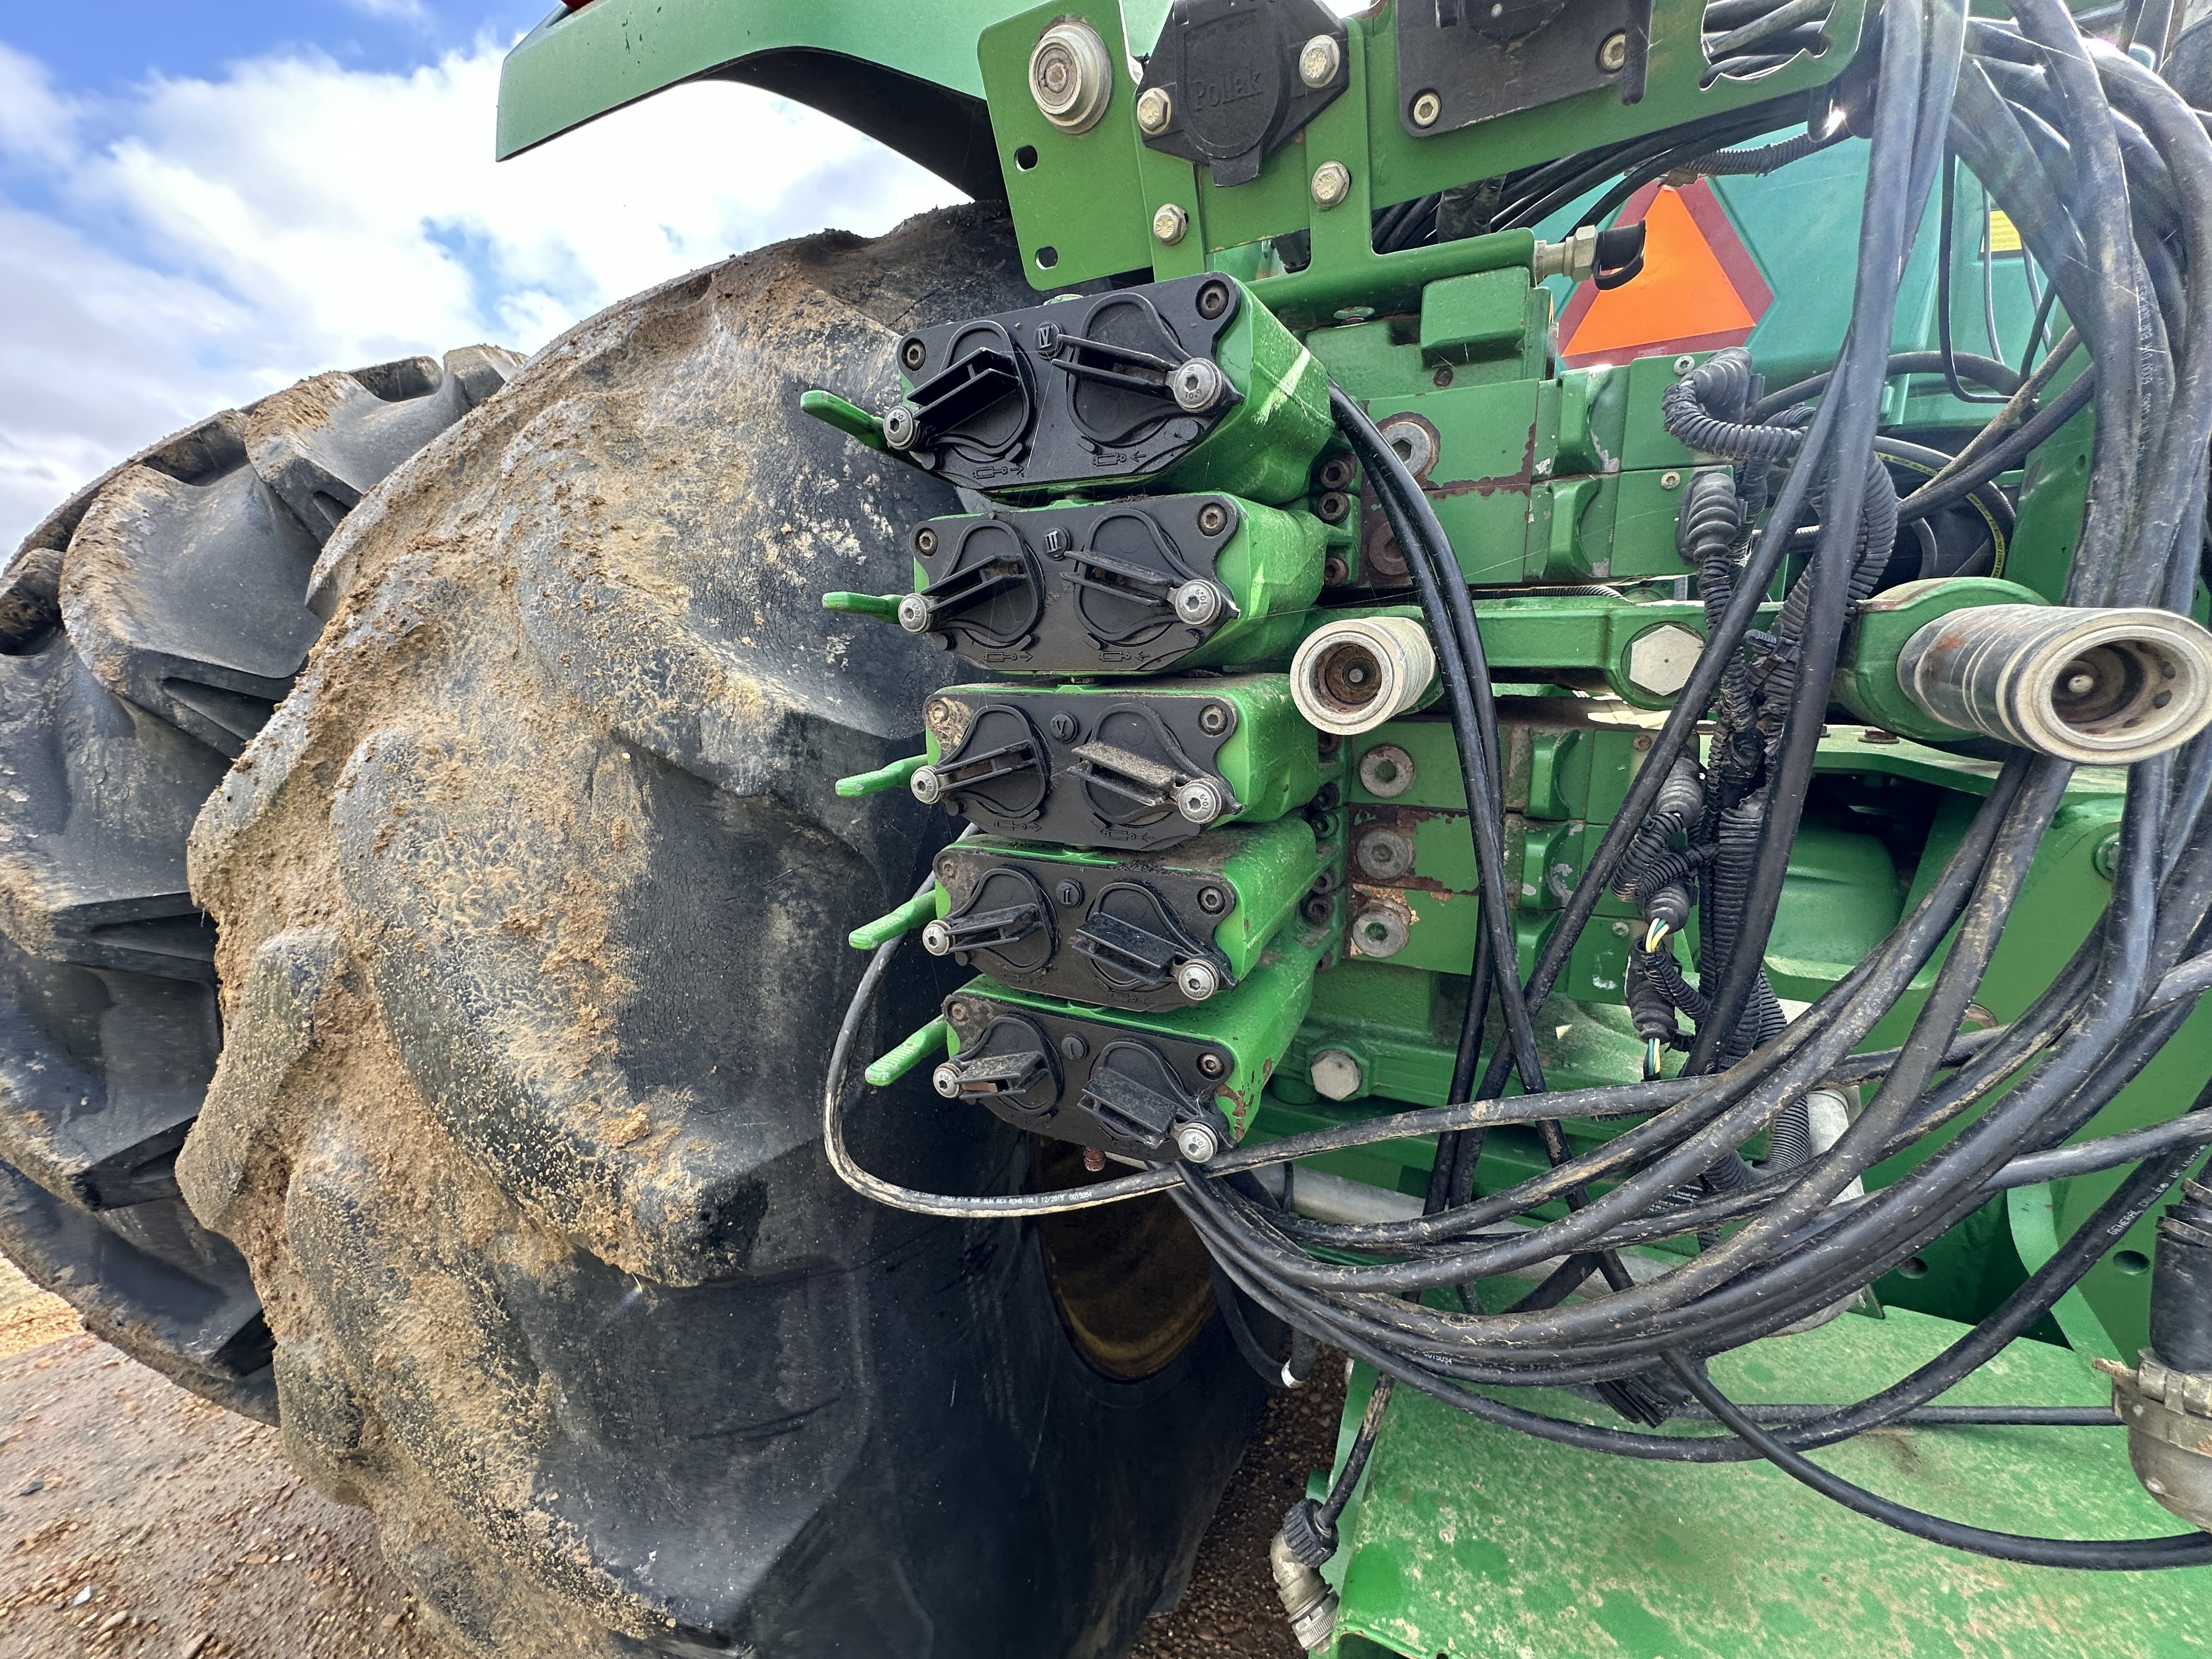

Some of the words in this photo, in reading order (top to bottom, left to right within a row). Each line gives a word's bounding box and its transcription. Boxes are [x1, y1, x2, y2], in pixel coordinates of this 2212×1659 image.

[1037, 325, 1053, 349] IV
[1184, 388, 1203, 400] 10.9
[1194, 588, 1207, 606] 10.9
[1198, 793, 1209, 811] 10.9
[1192, 1136, 1205, 1150] 10.9
[2106, 1210, 2144, 1235] GENERAL
